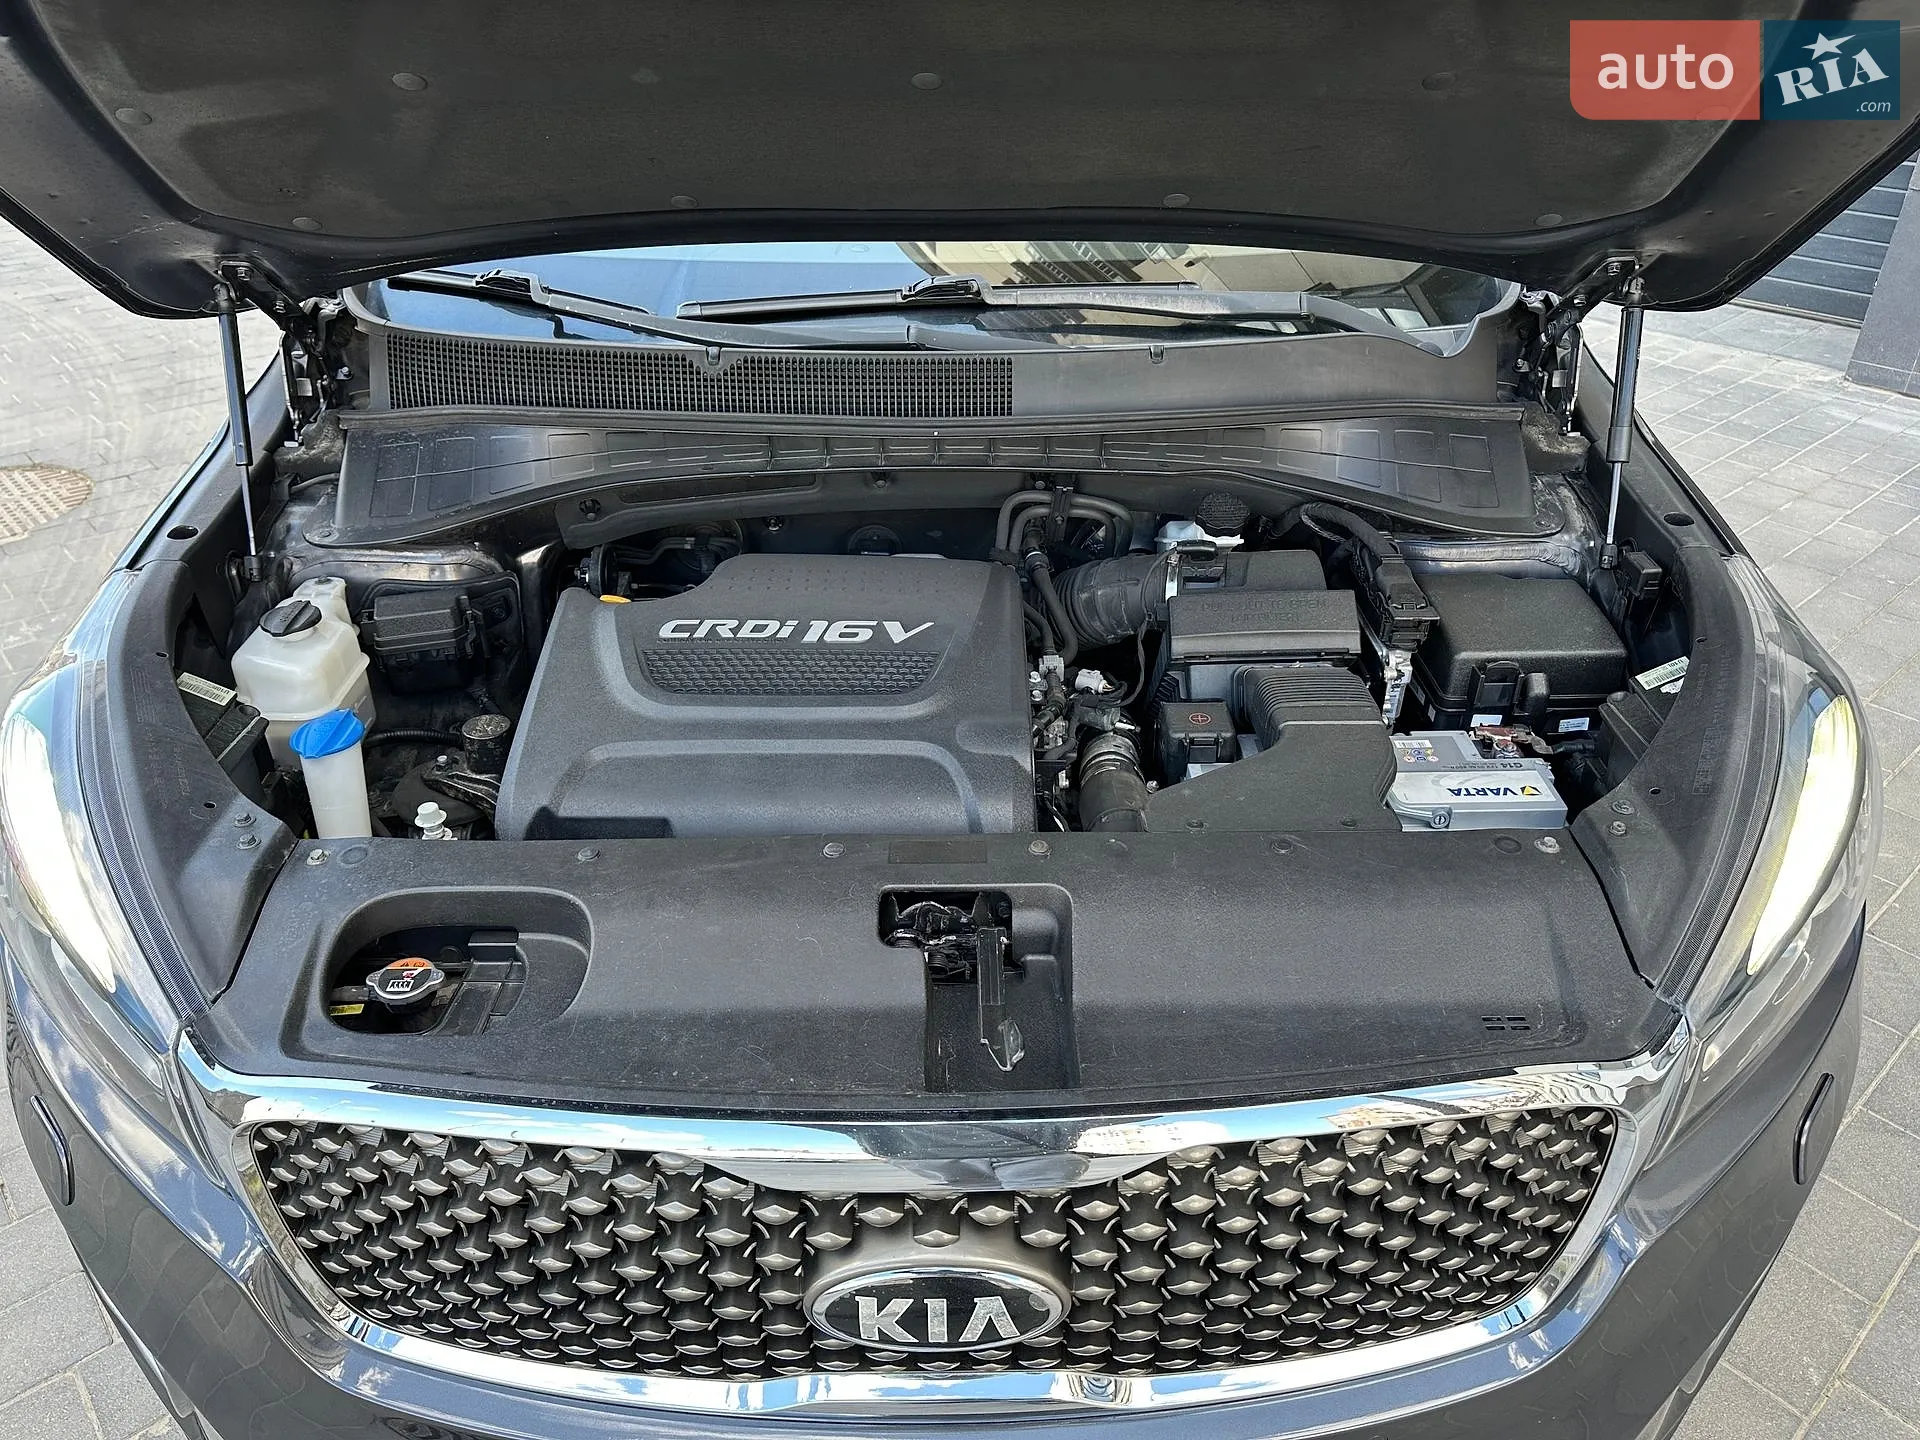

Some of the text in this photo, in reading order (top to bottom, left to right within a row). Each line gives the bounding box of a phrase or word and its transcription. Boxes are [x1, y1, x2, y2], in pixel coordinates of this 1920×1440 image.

[658, 618, 935, 644] CRDi 16V
[1446, 787, 1519, 797] VARTA
[855, 1295, 1021, 1343] KIA
